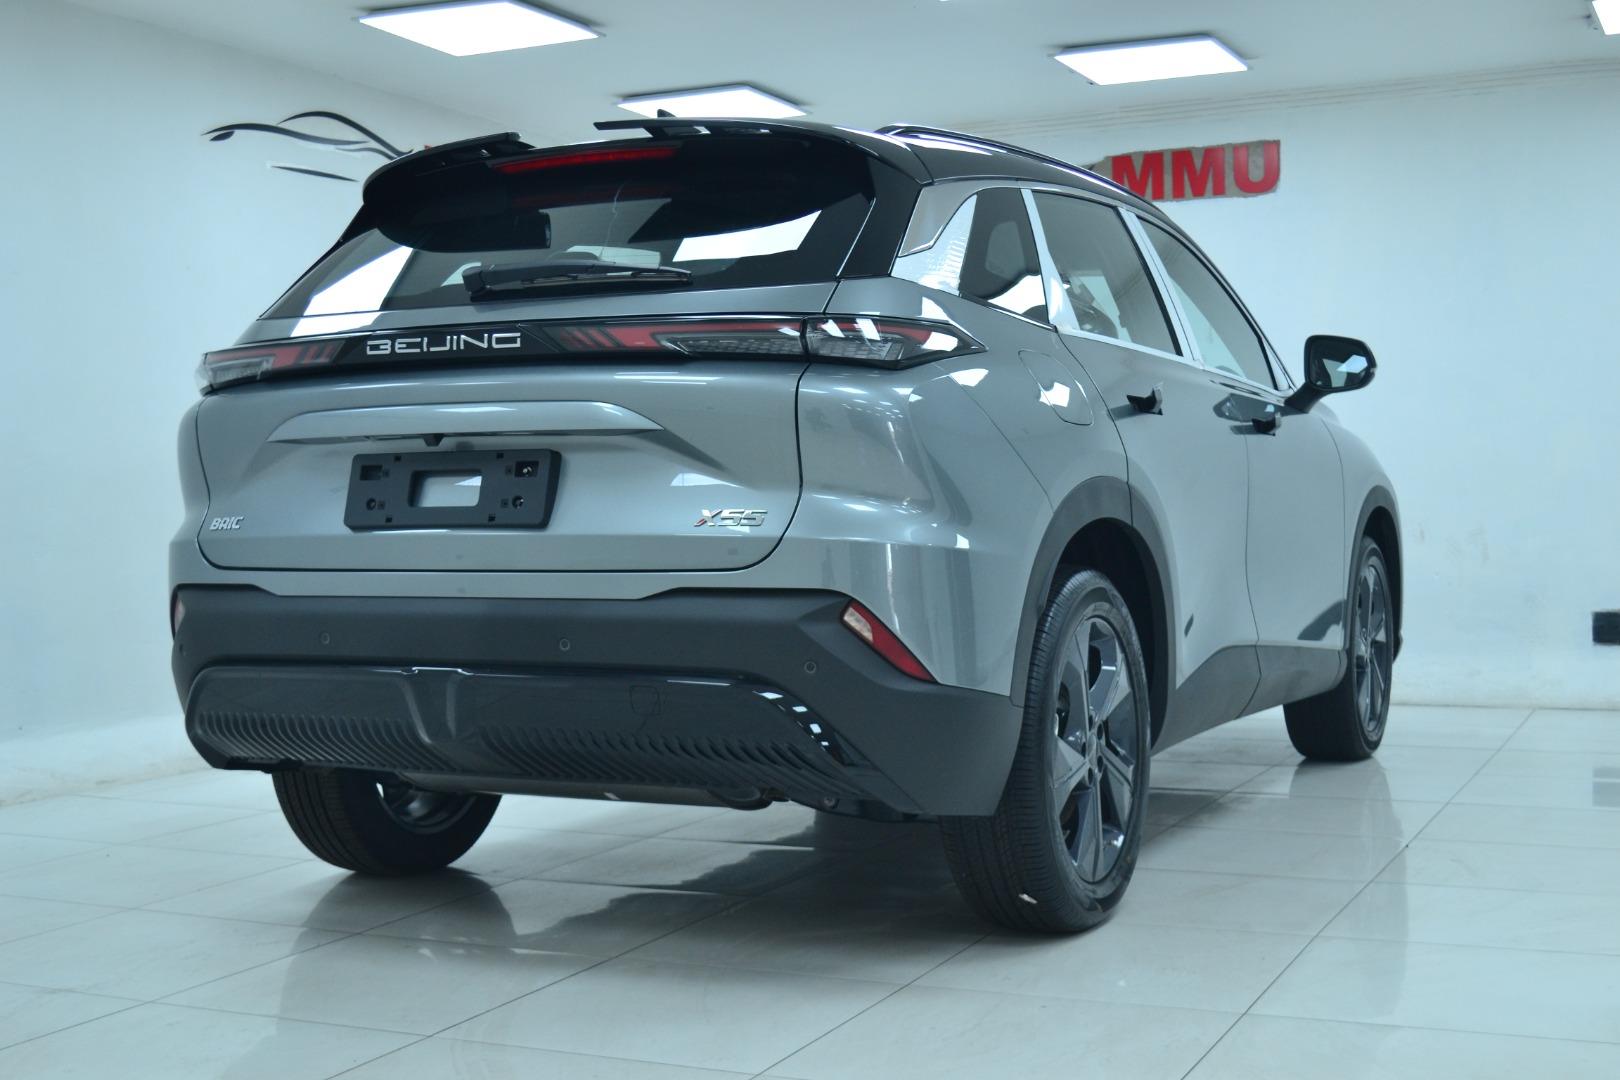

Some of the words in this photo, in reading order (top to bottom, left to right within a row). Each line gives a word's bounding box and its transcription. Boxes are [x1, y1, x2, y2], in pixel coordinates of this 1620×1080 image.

[366, 332, 522, 355] BEIJING
[209, 516, 244, 531] BAIC
[693, 508, 769, 528] X55
